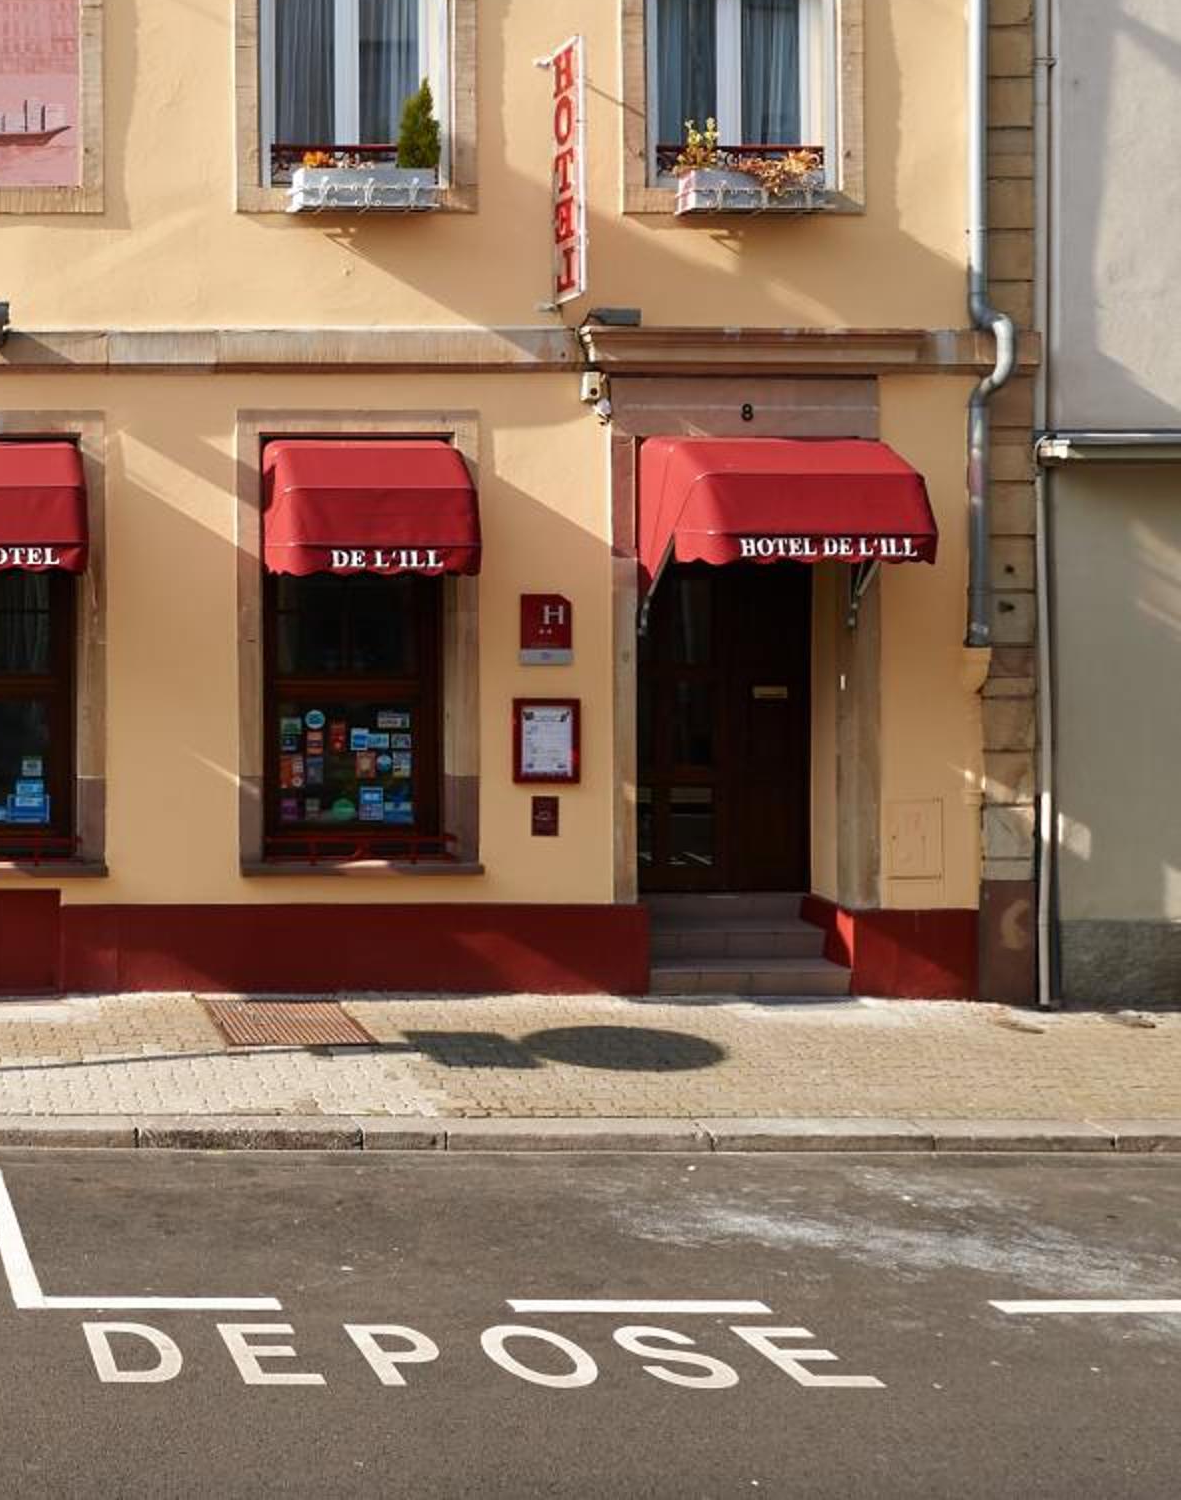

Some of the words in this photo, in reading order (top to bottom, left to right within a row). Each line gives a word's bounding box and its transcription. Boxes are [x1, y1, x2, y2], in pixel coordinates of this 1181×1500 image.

[741, 403, 754, 421] 8
[738, 537, 818, 557] HOTEL
[822, 537, 854, 556] DE
[858, 537, 918, 557] L'ILL
[330, 549, 366, 568] DE
[374, 549, 444, 568] L'ILL
[544, 605, 564, 625] H
[81, 1322, 886, 1390] DEPOSE
